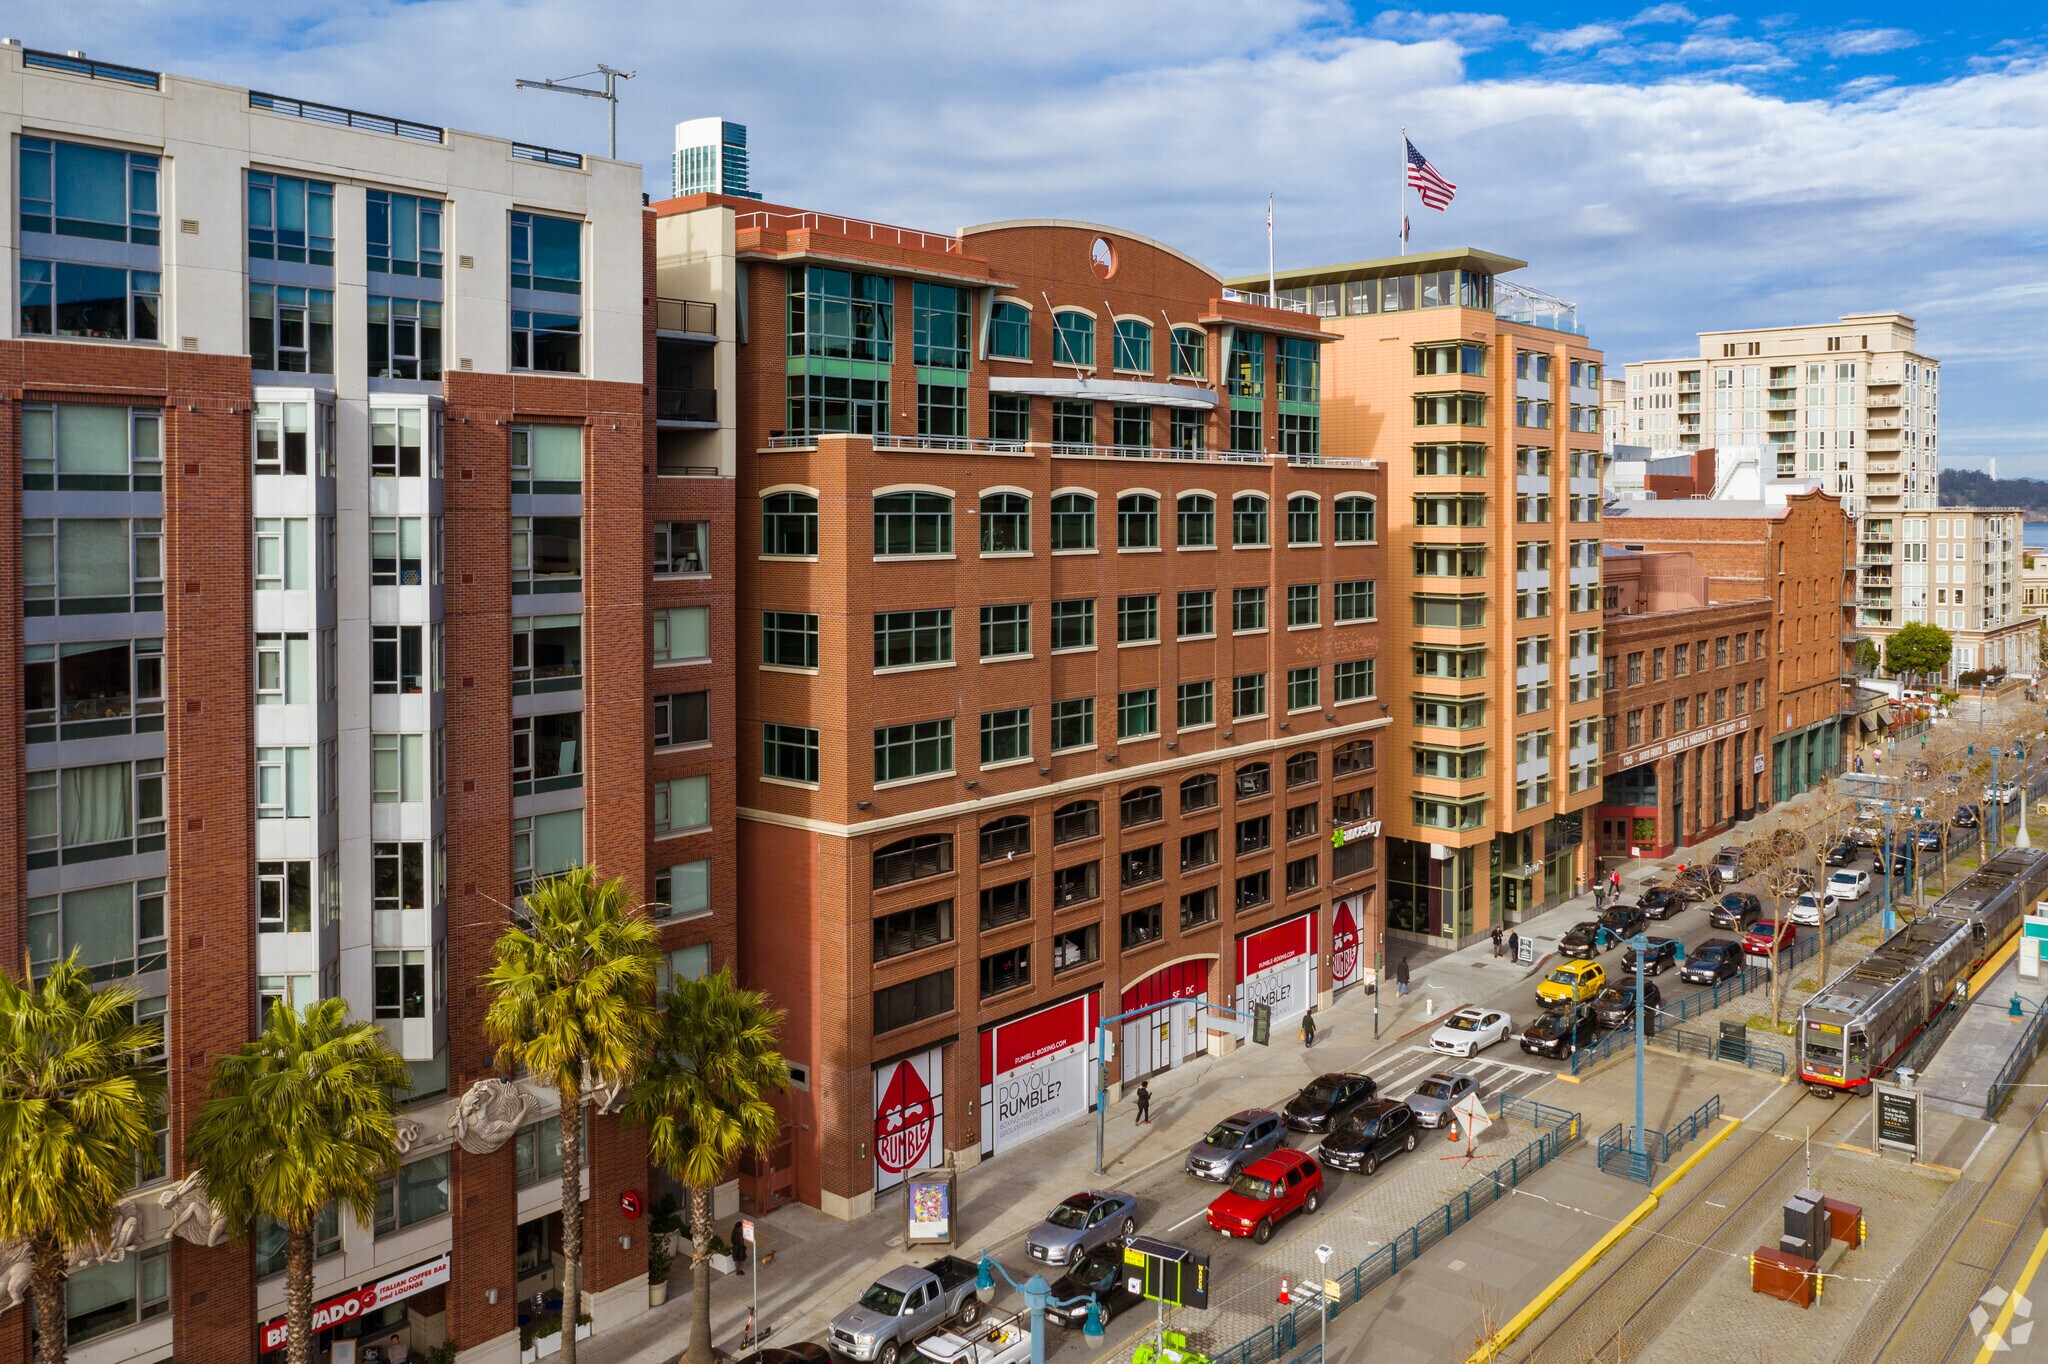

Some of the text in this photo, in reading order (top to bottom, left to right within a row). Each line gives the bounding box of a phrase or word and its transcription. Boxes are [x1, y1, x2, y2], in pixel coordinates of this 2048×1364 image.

[1343, 821, 1382, 841] ancestry
[1172, 989, 1181, 1000] SF
[1185, 984, 1195, 995] DC
[1248, 973, 1283, 1000] DO YOU
[1014, 1038, 1067, 1064] RUMBLE-BOXING.COM
[999, 1068, 1051, 1104] DO YOU
[999, 1080, 1062, 1121] RUMBLE?
[999, 1106, 1060, 1138] GROUP FITNESS CLASSES
[881, 1121, 927, 1165] RUMBLE
[379, 1264, 447, 1294] ITALIAN COFFEE BAR
[380, 1280, 424, 1302] and LOUNGE
